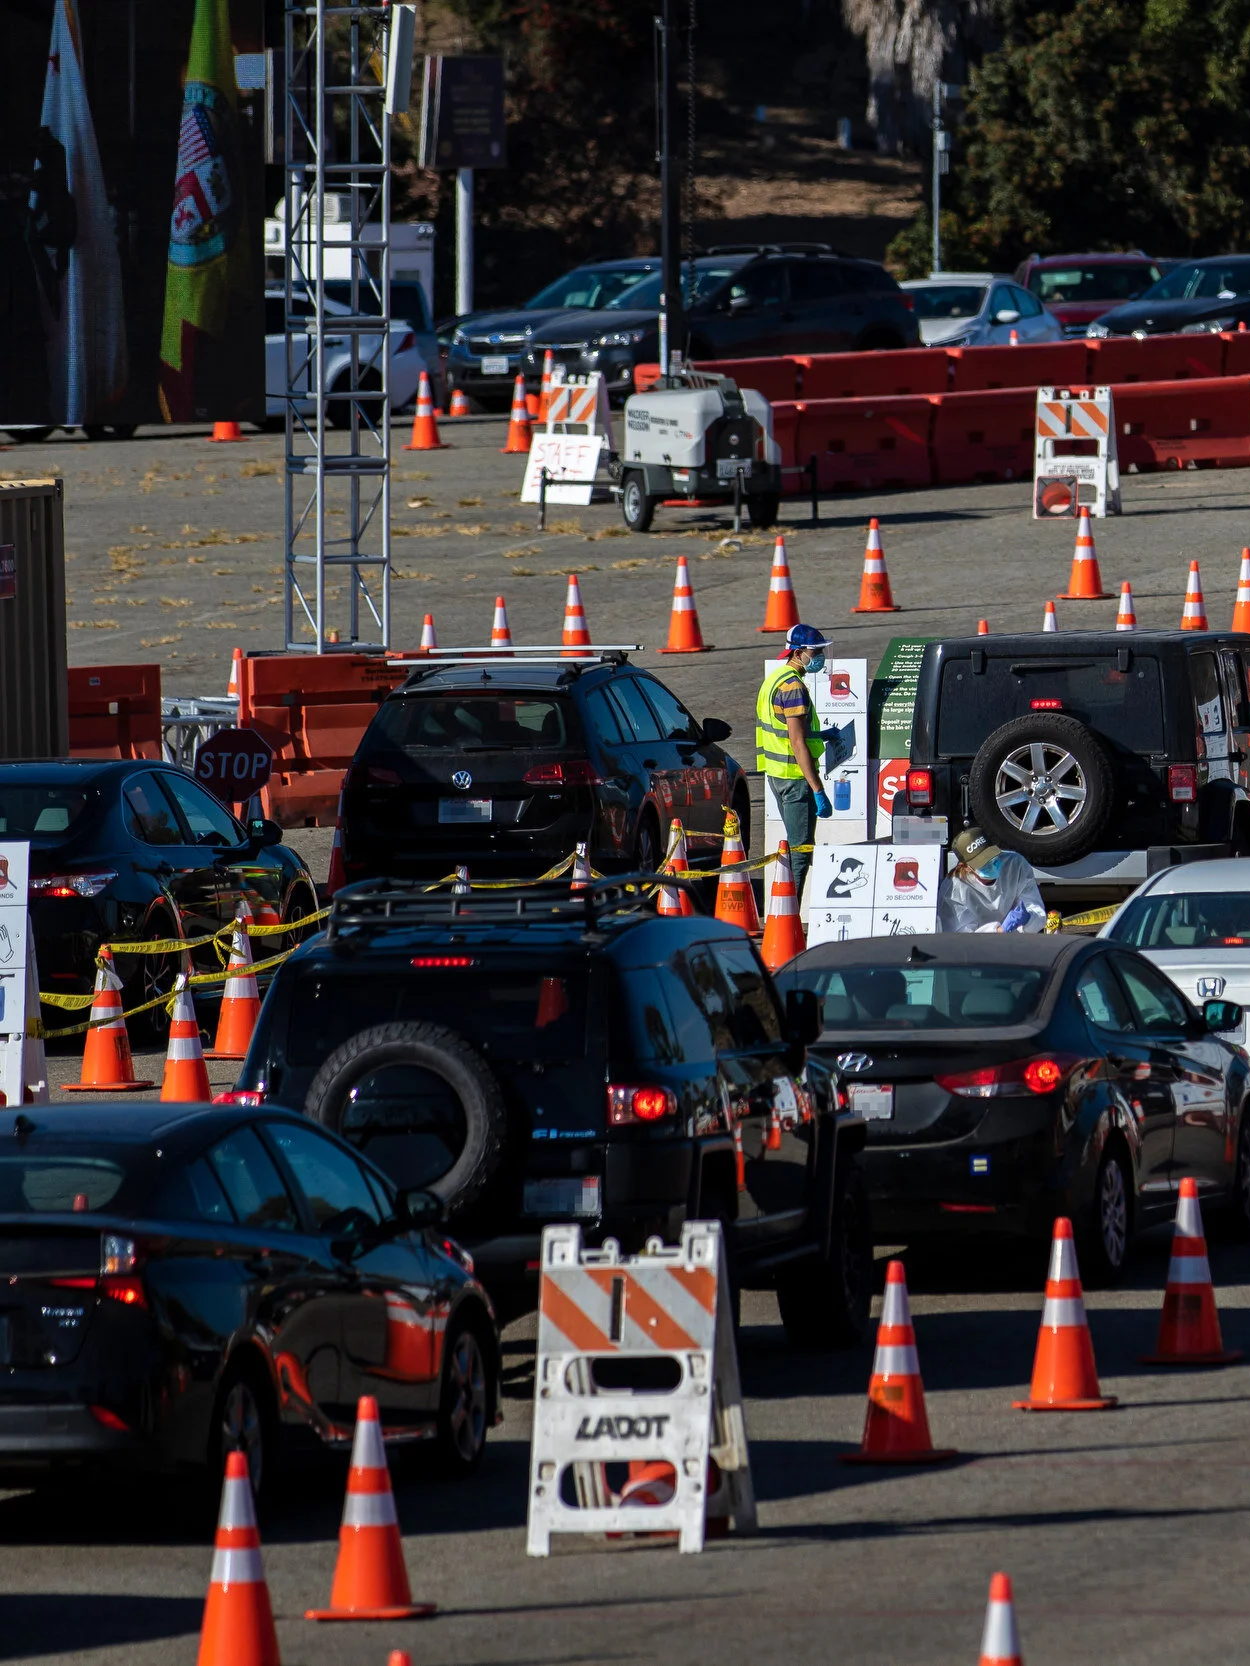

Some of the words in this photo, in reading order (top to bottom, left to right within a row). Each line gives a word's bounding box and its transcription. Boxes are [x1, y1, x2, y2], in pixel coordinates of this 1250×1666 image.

[823, 717, 832, 726] 4.
[199, 752, 268, 779] STOP
[966, 836, 987, 854] CORE
[829, 853, 839, 863] 1.
[886, 852, 896, 862] 2.
[720, 902, 745, 911] DWP
[825, 913, 835, 923] 3.
[882, 912, 892, 923] 4.
[575, 1414, 671, 1440] LADOT
